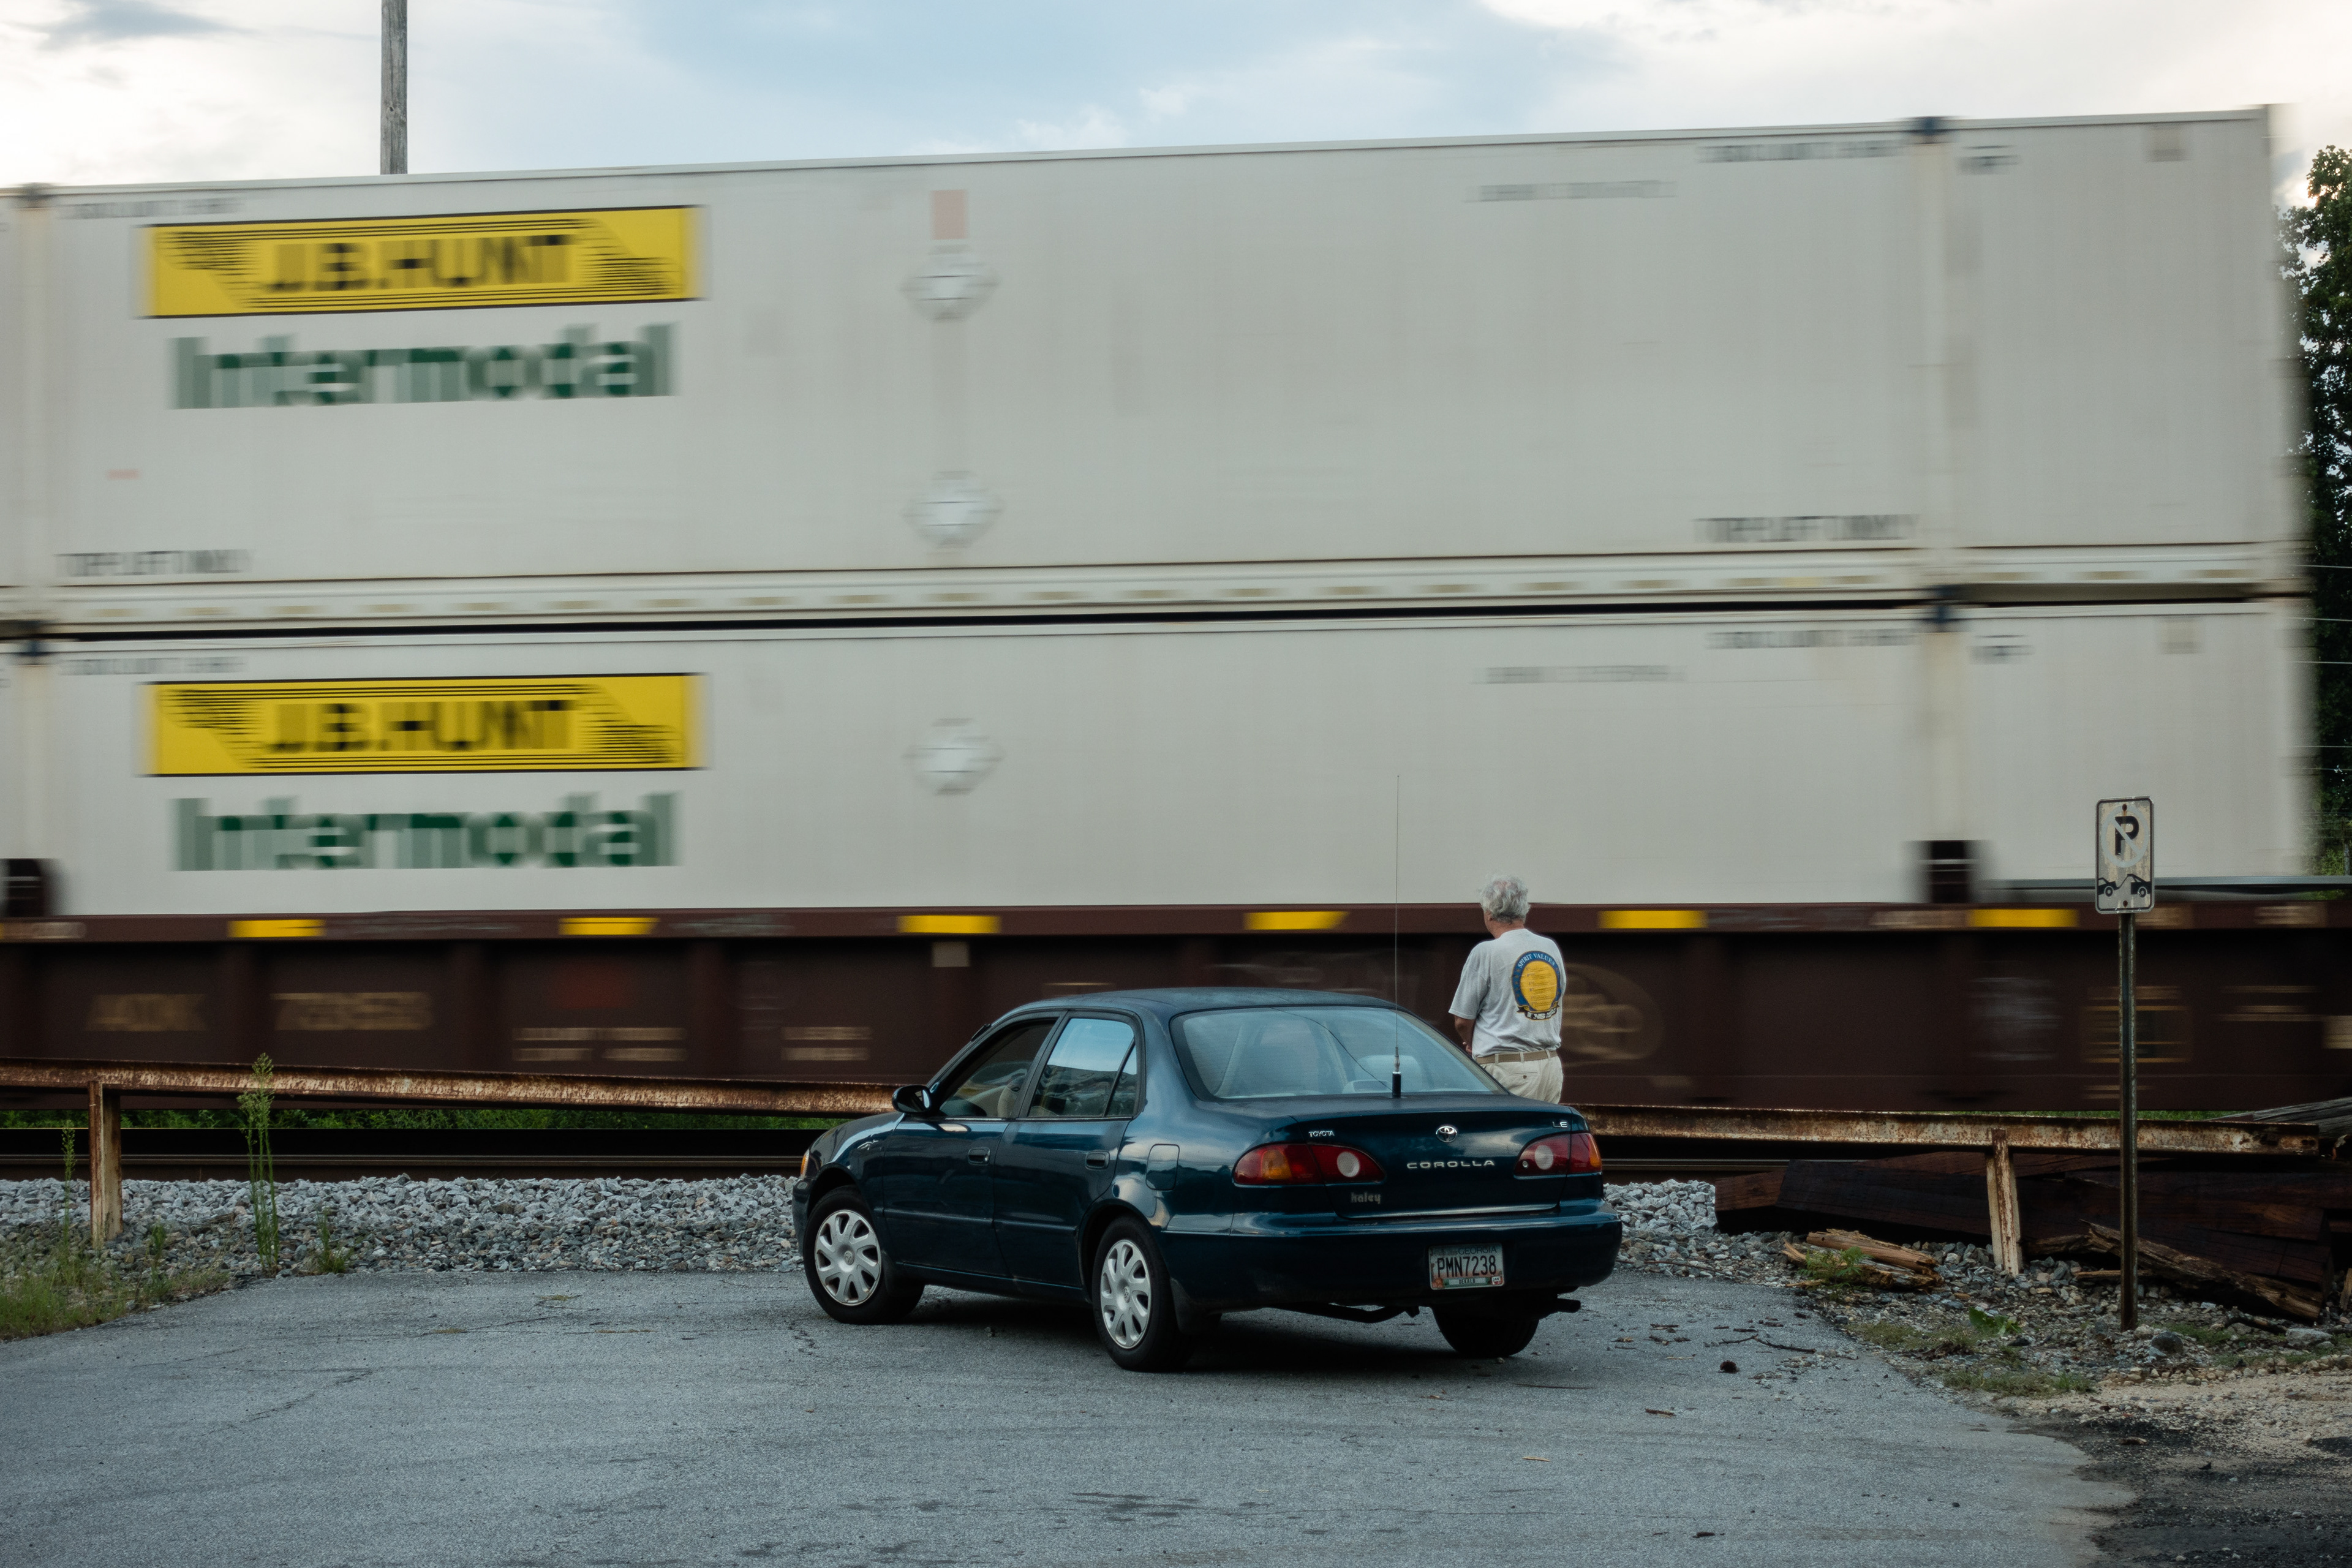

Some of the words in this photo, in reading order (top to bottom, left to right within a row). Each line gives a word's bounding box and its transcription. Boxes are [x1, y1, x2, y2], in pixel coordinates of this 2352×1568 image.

[168, 323, 680, 409] Intermodal
[169, 791, 684, 871] Intermodal
[1518, 954, 1532, 968] SPIRIT
[1533, 953, 1555, 966] VALUES
[1406, 1159, 1495, 1169] COROLLA
[1350, 1192, 1382, 1205] haley
[1437, 1255, 1496, 1278] PMN7238
